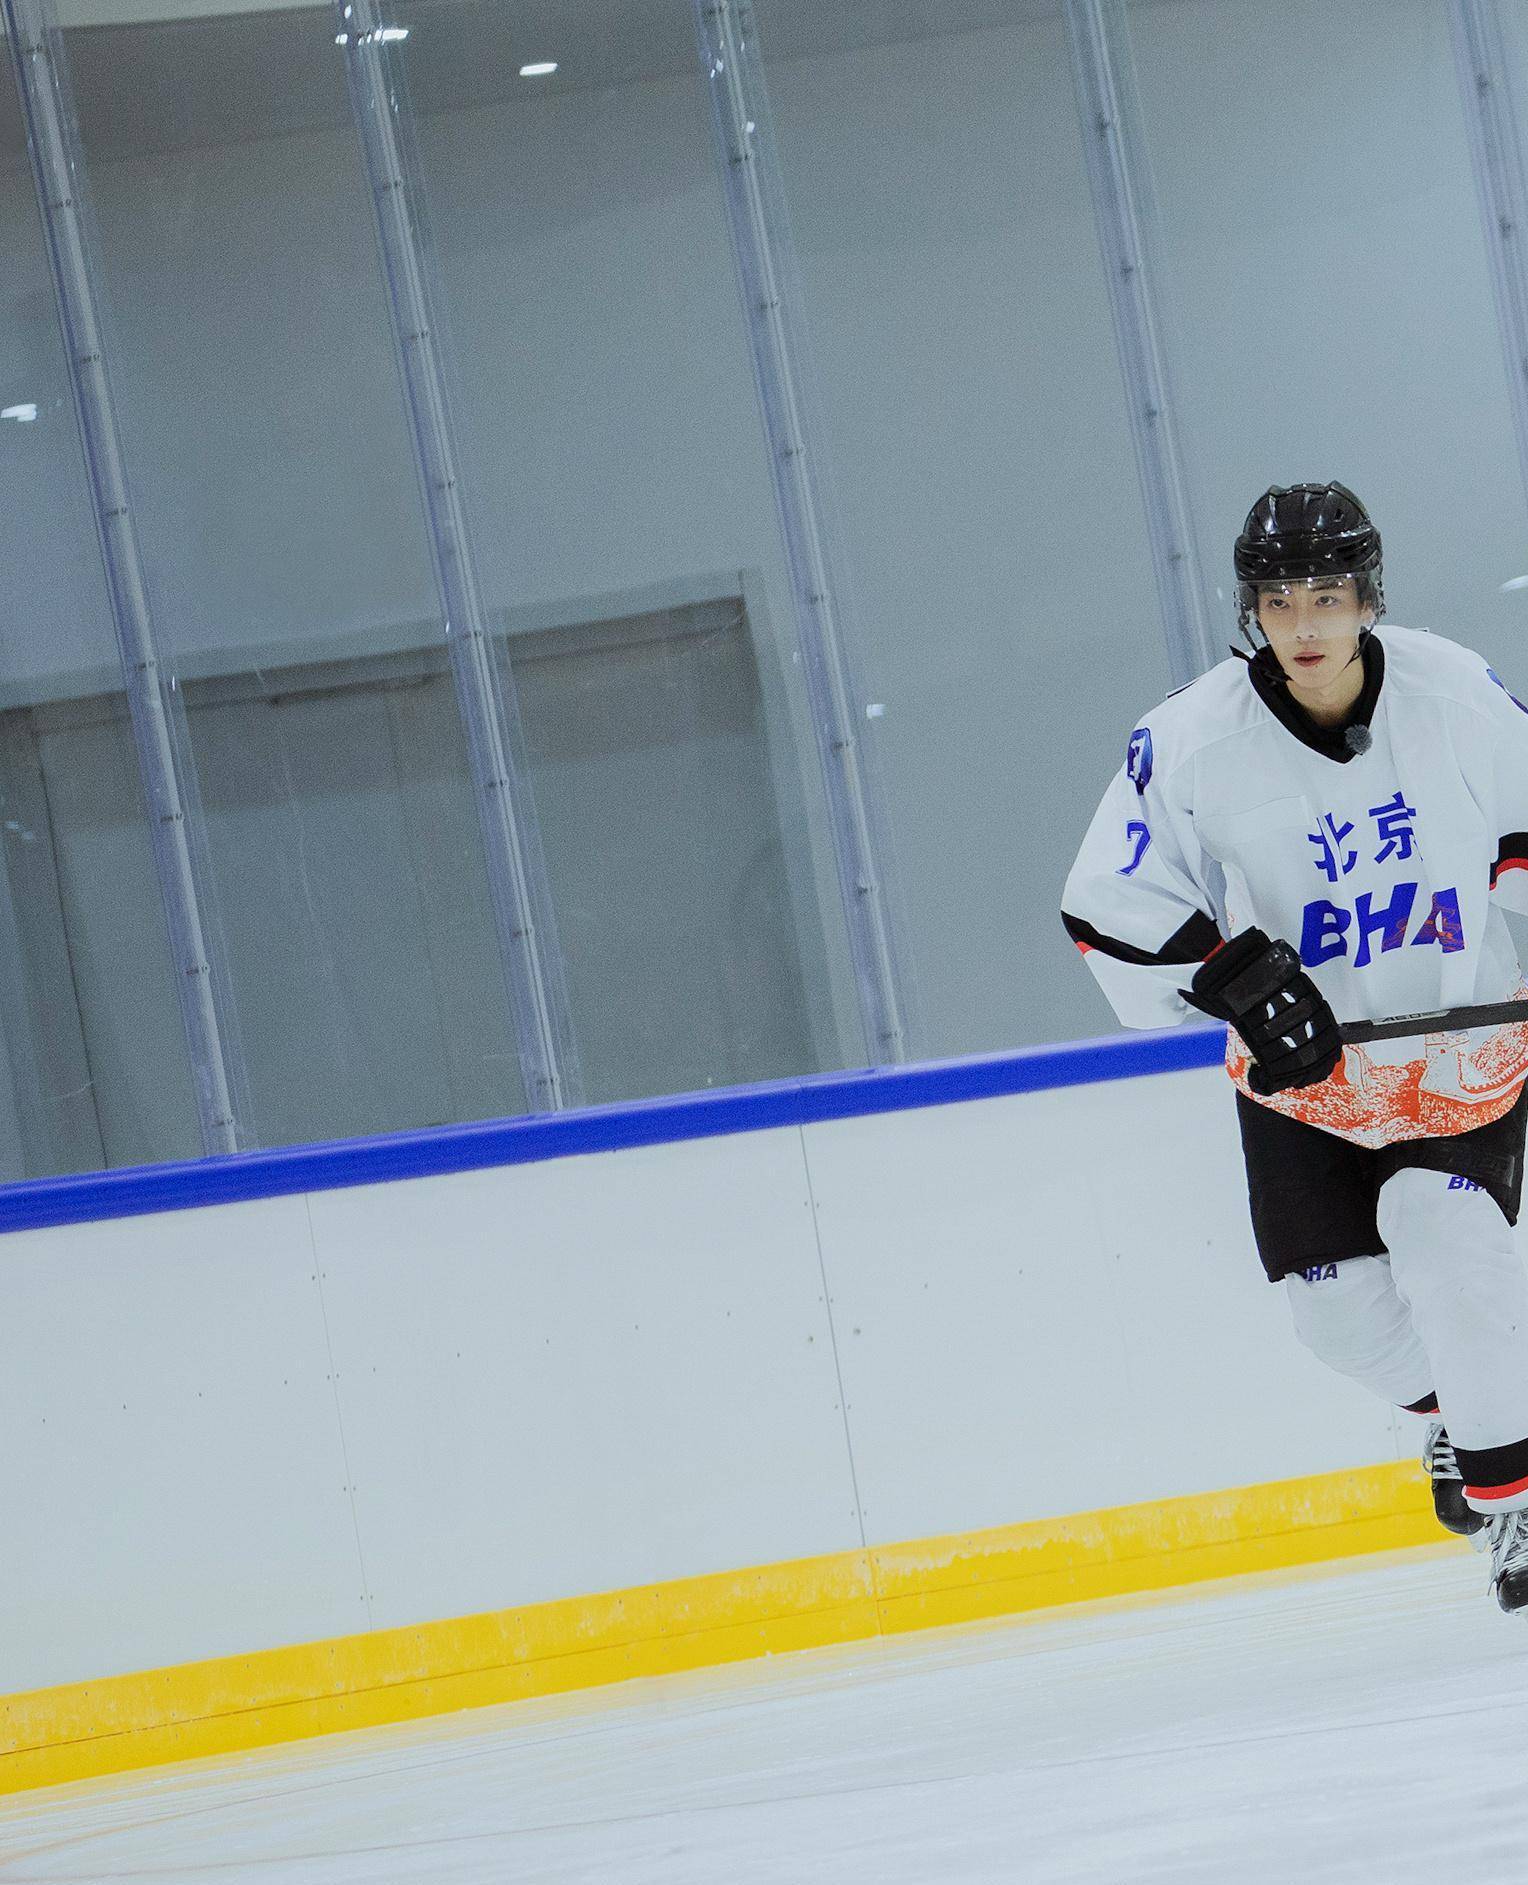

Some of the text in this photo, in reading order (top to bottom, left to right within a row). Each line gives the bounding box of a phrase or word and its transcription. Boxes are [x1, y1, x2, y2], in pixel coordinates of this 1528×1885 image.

[1115, 820, 1152, 876] 7
[1307, 791, 1423, 882] 北京
[1300, 882, 1465, 968] BHA
[1448, 1176, 1485, 1192] BH
[1304, 1263, 1338, 1282] HA
